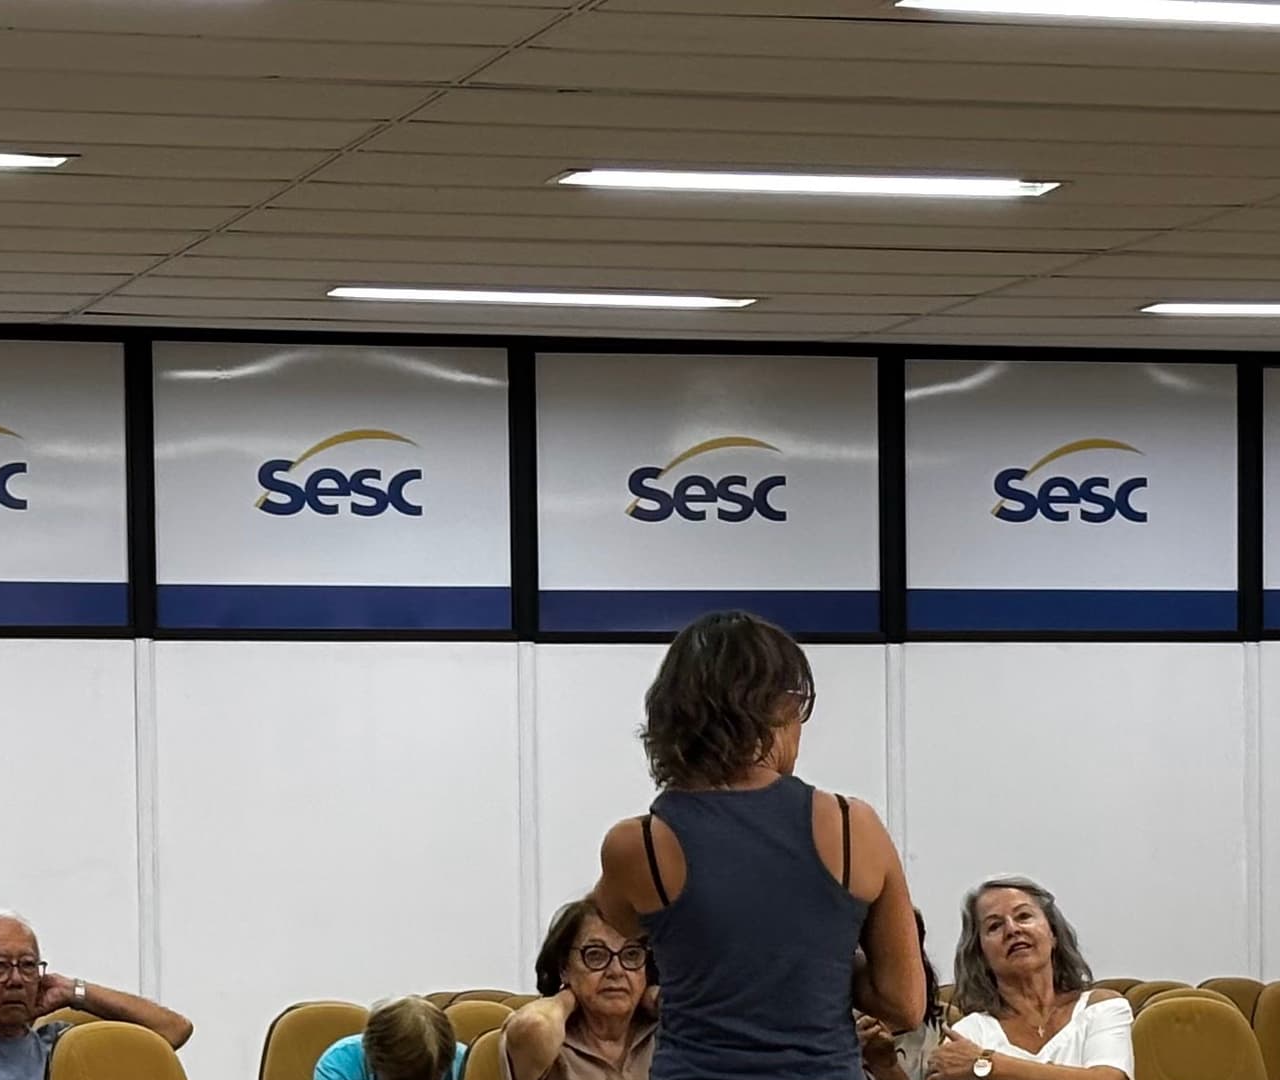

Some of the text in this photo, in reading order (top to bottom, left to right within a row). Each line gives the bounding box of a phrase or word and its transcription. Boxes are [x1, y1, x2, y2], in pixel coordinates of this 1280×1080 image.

[257, 459, 422, 516] Sesc
[628, 465, 788, 522] Sesc
[993, 467, 1148, 523] Sesc
